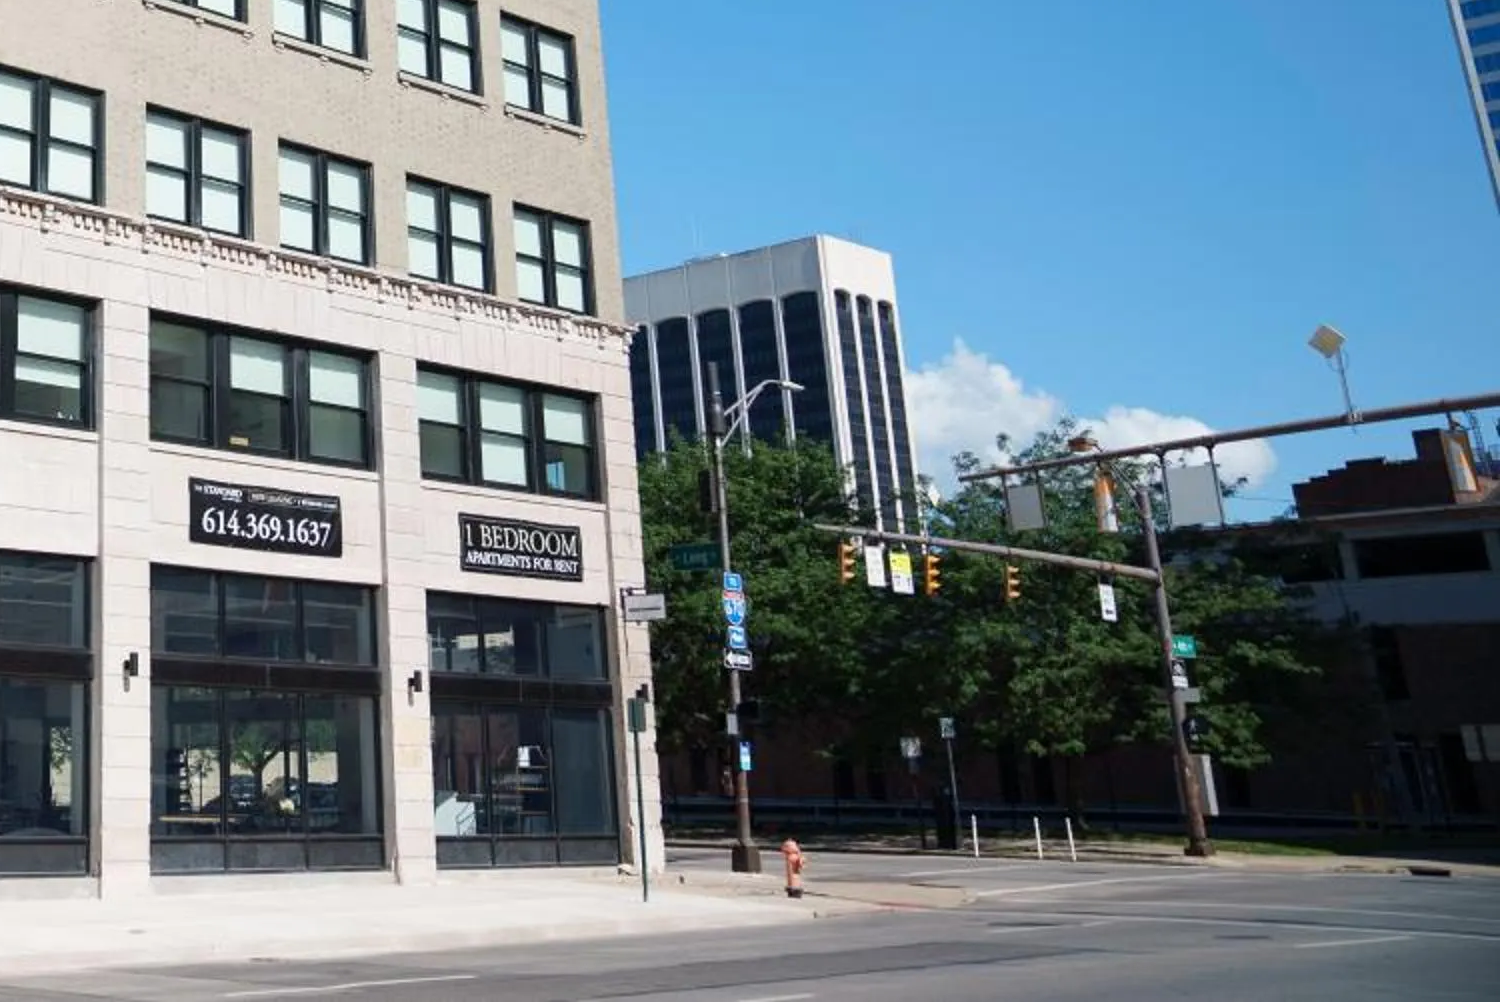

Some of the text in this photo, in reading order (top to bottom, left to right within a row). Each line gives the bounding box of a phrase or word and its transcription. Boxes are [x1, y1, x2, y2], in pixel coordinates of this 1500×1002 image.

[202, 507, 332, 548] 614.369.1637
[465, 523, 578, 557] 1 BEDROOM
[465, 550, 579, 573] APARTMENTS FOR RENT
